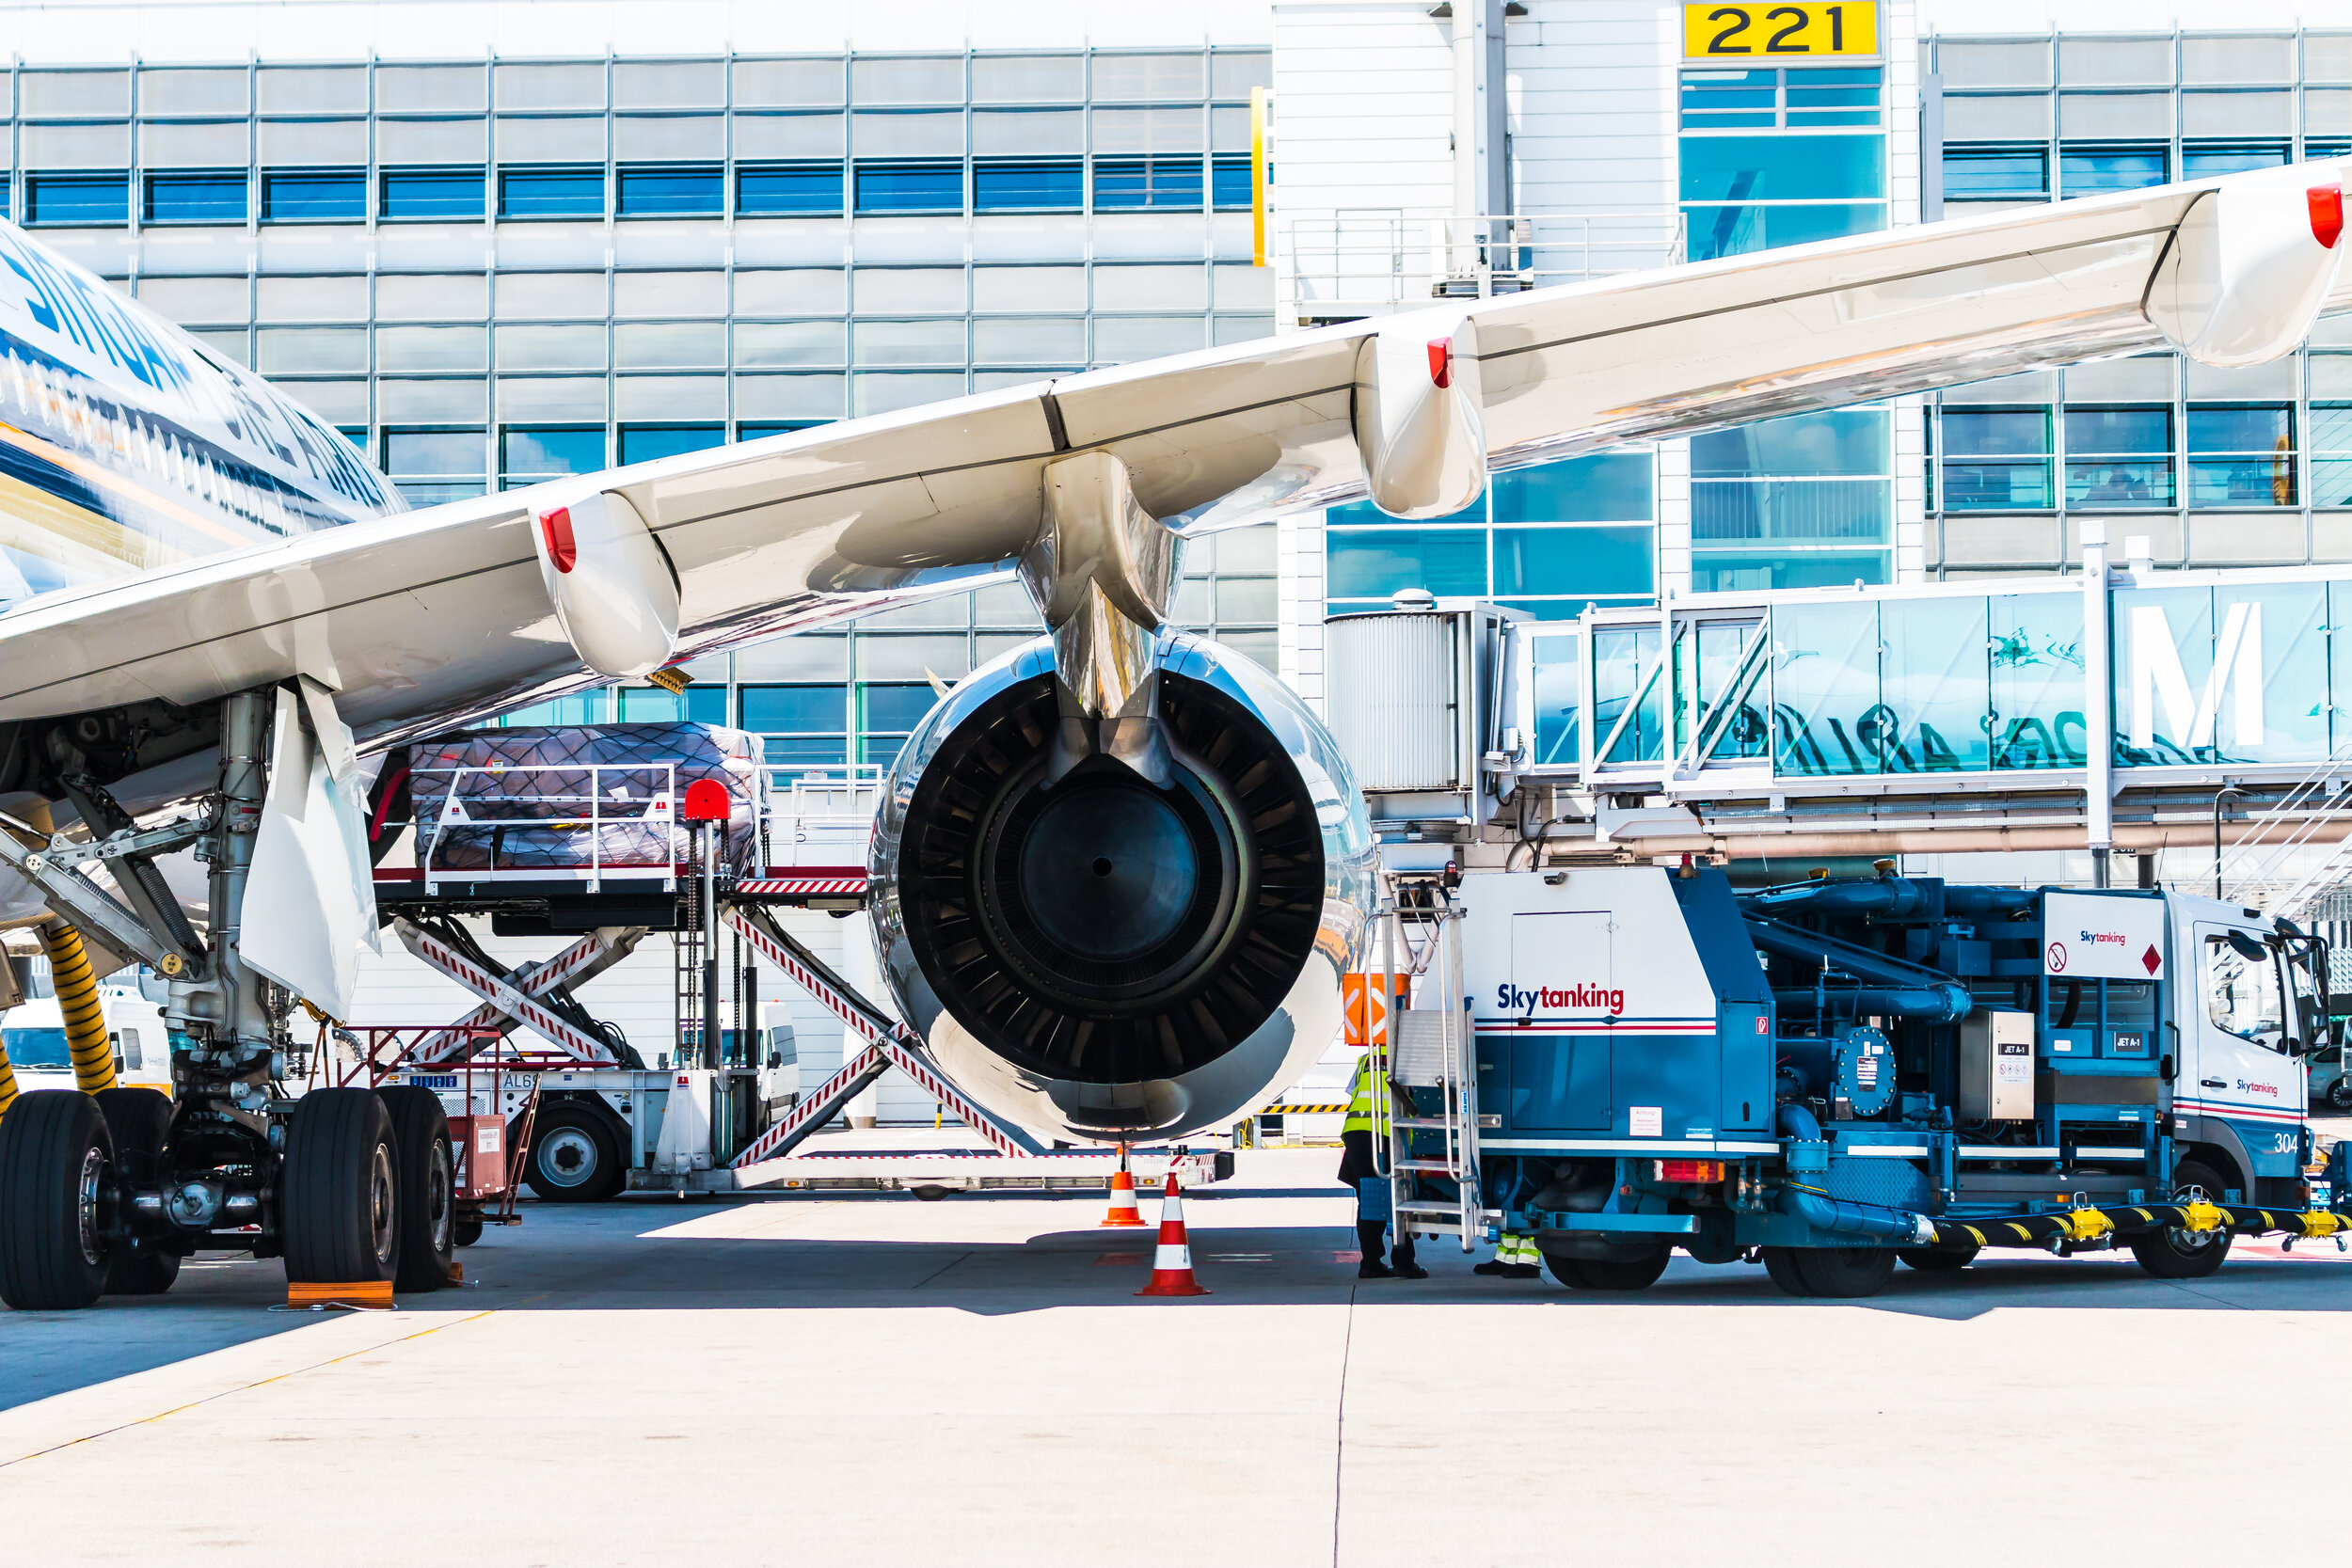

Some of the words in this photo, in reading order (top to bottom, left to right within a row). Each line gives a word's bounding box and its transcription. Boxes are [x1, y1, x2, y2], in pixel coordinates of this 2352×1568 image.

[1708, 7, 1843, 53] 221
[2129, 602, 2264, 749] M
[2080, 930, 2126, 946] Skytanking
[1497, 982, 1625, 1017] Skytanking
[2118, 1037, 2129, 1046] JET
[2130, 1037, 2140, 1046] A-1
[2236, 1079, 2279, 1098] Skytanking
[2274, 1132, 2298, 1154] 304
